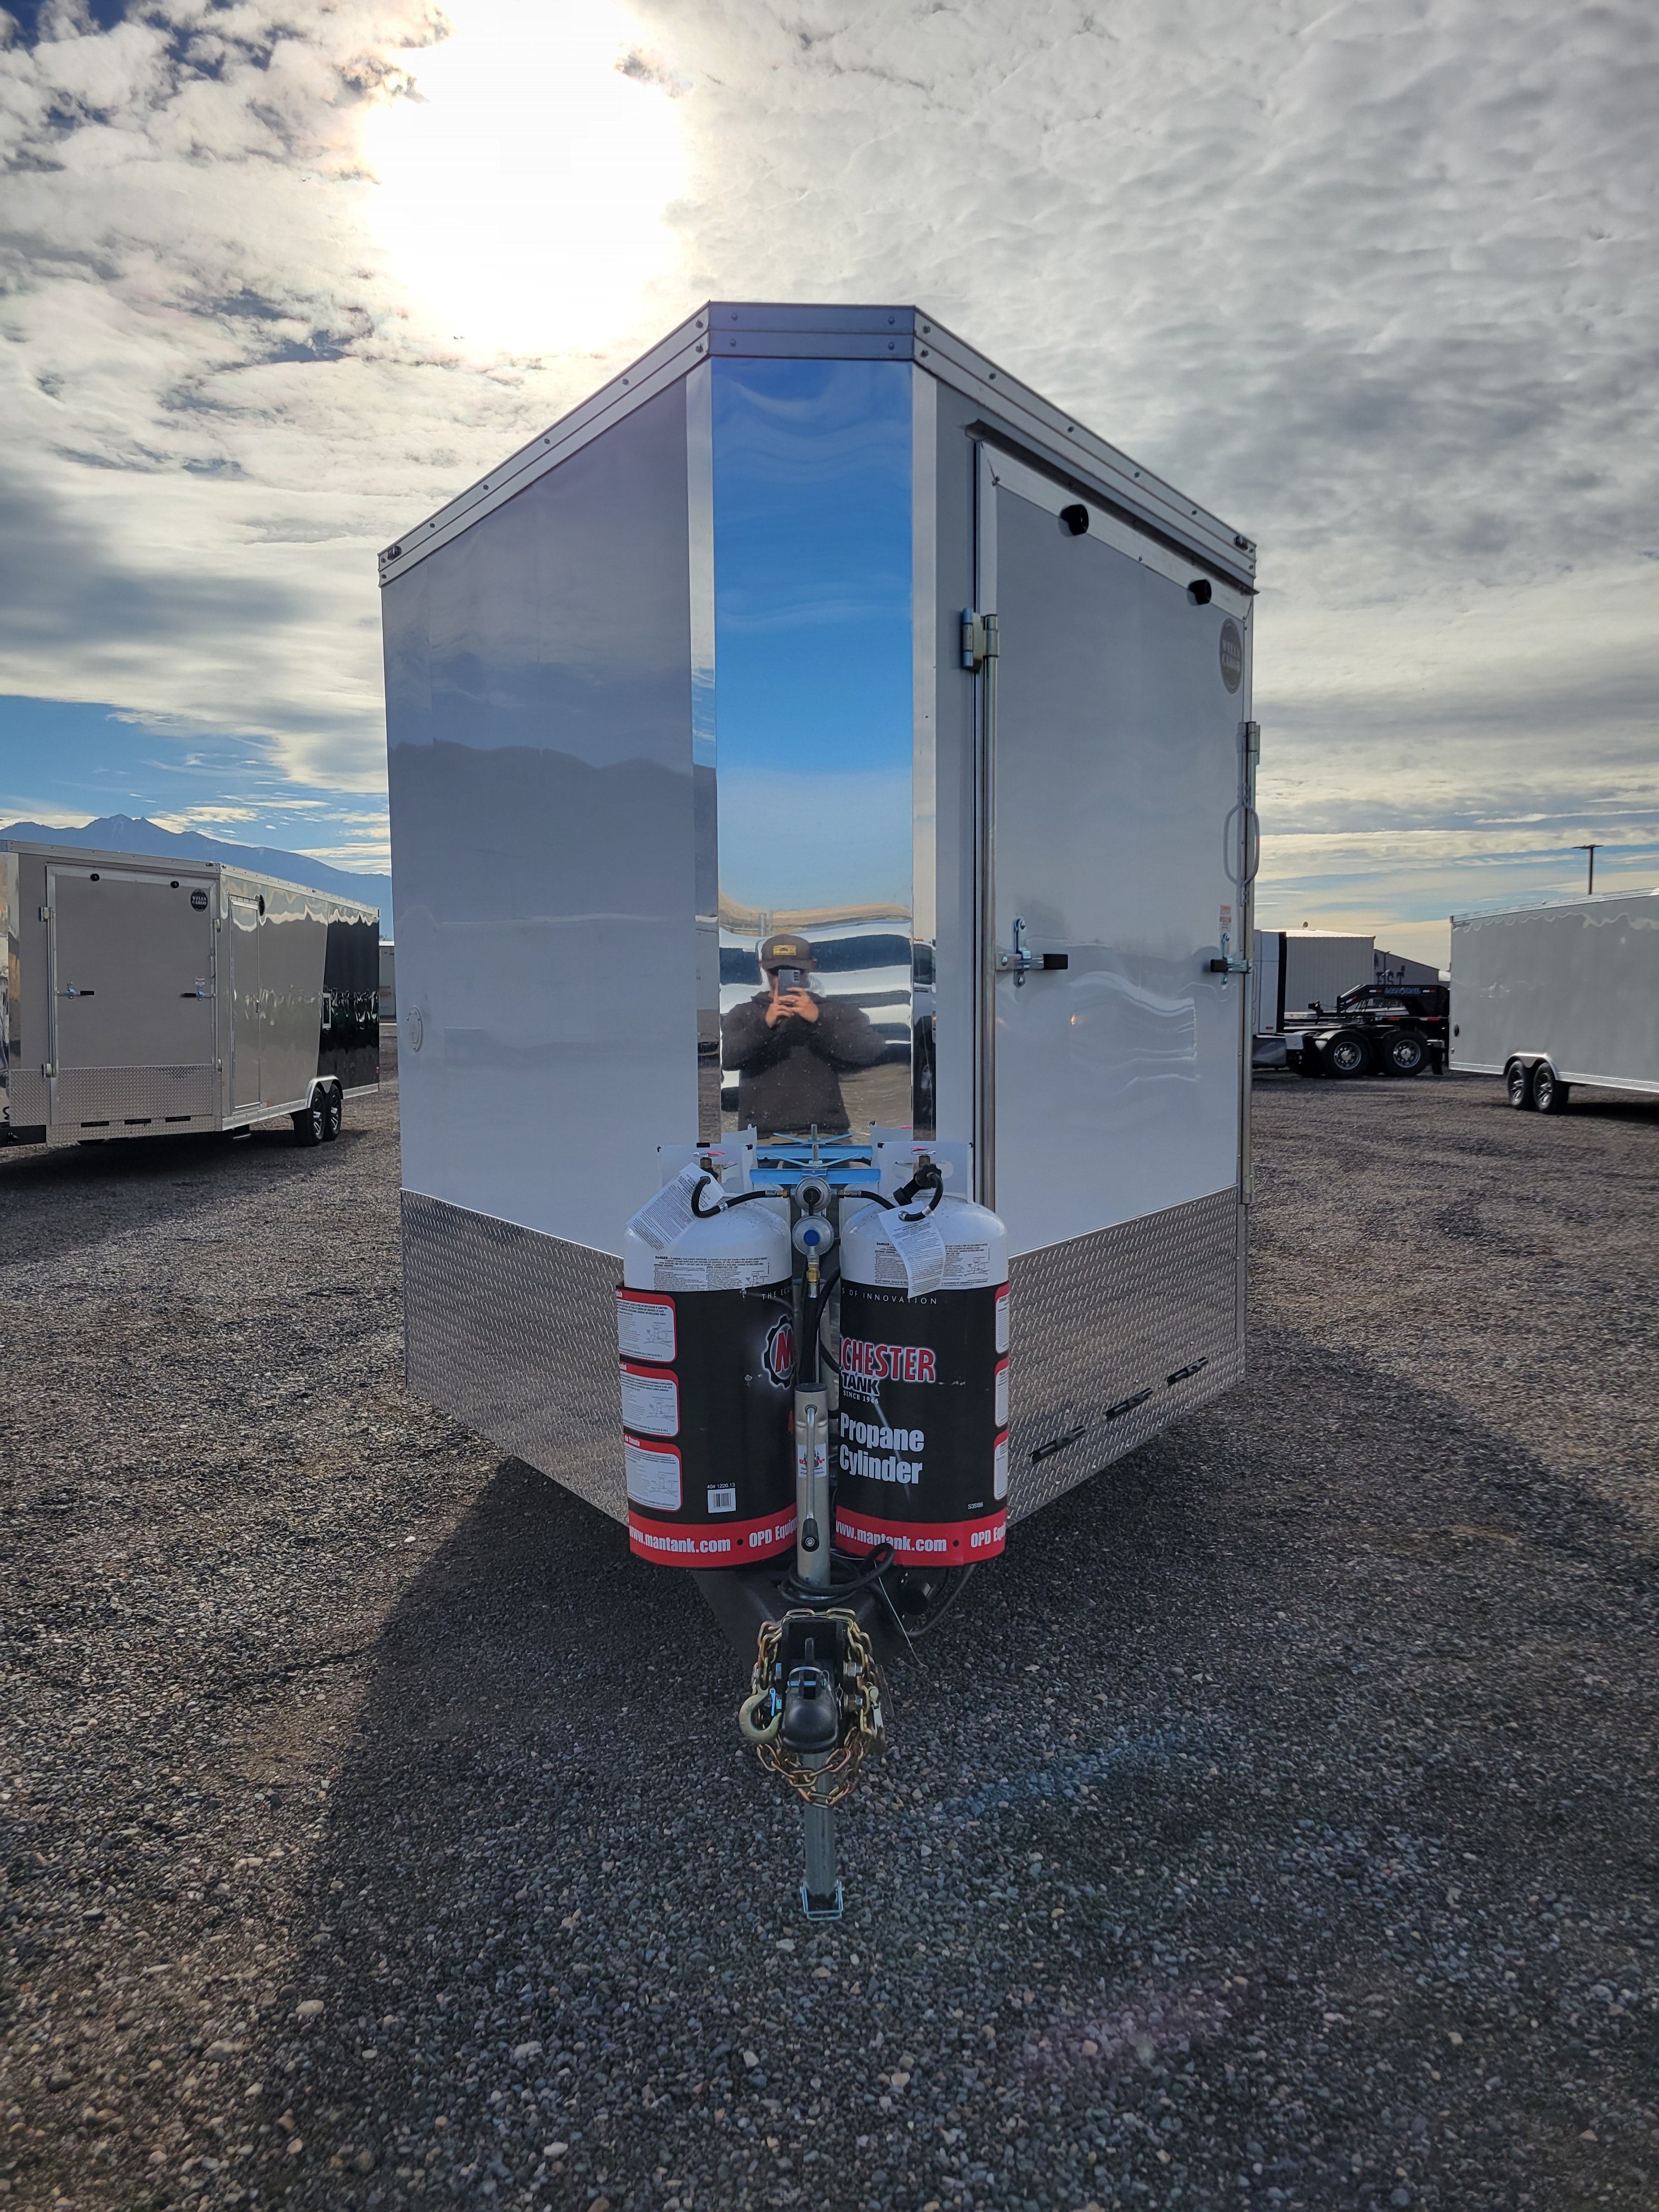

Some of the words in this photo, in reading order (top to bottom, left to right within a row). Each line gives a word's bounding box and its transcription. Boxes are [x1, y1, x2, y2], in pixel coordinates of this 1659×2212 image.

[761, 1291, 776, 1301] THE
[863, 1291, 937, 1305] INNOVATION
[839, 1336, 935, 1382] CHESTER
[842, 1371, 879, 1396] TANK
[843, 1390, 860, 1400] SINCE
[840, 1412, 924, 1452] Propane
[840, 1444, 923, 1484] Cylinder
[749, 1529, 772, 1548] OPD
[970, 1530, 991, 1548] OPD
